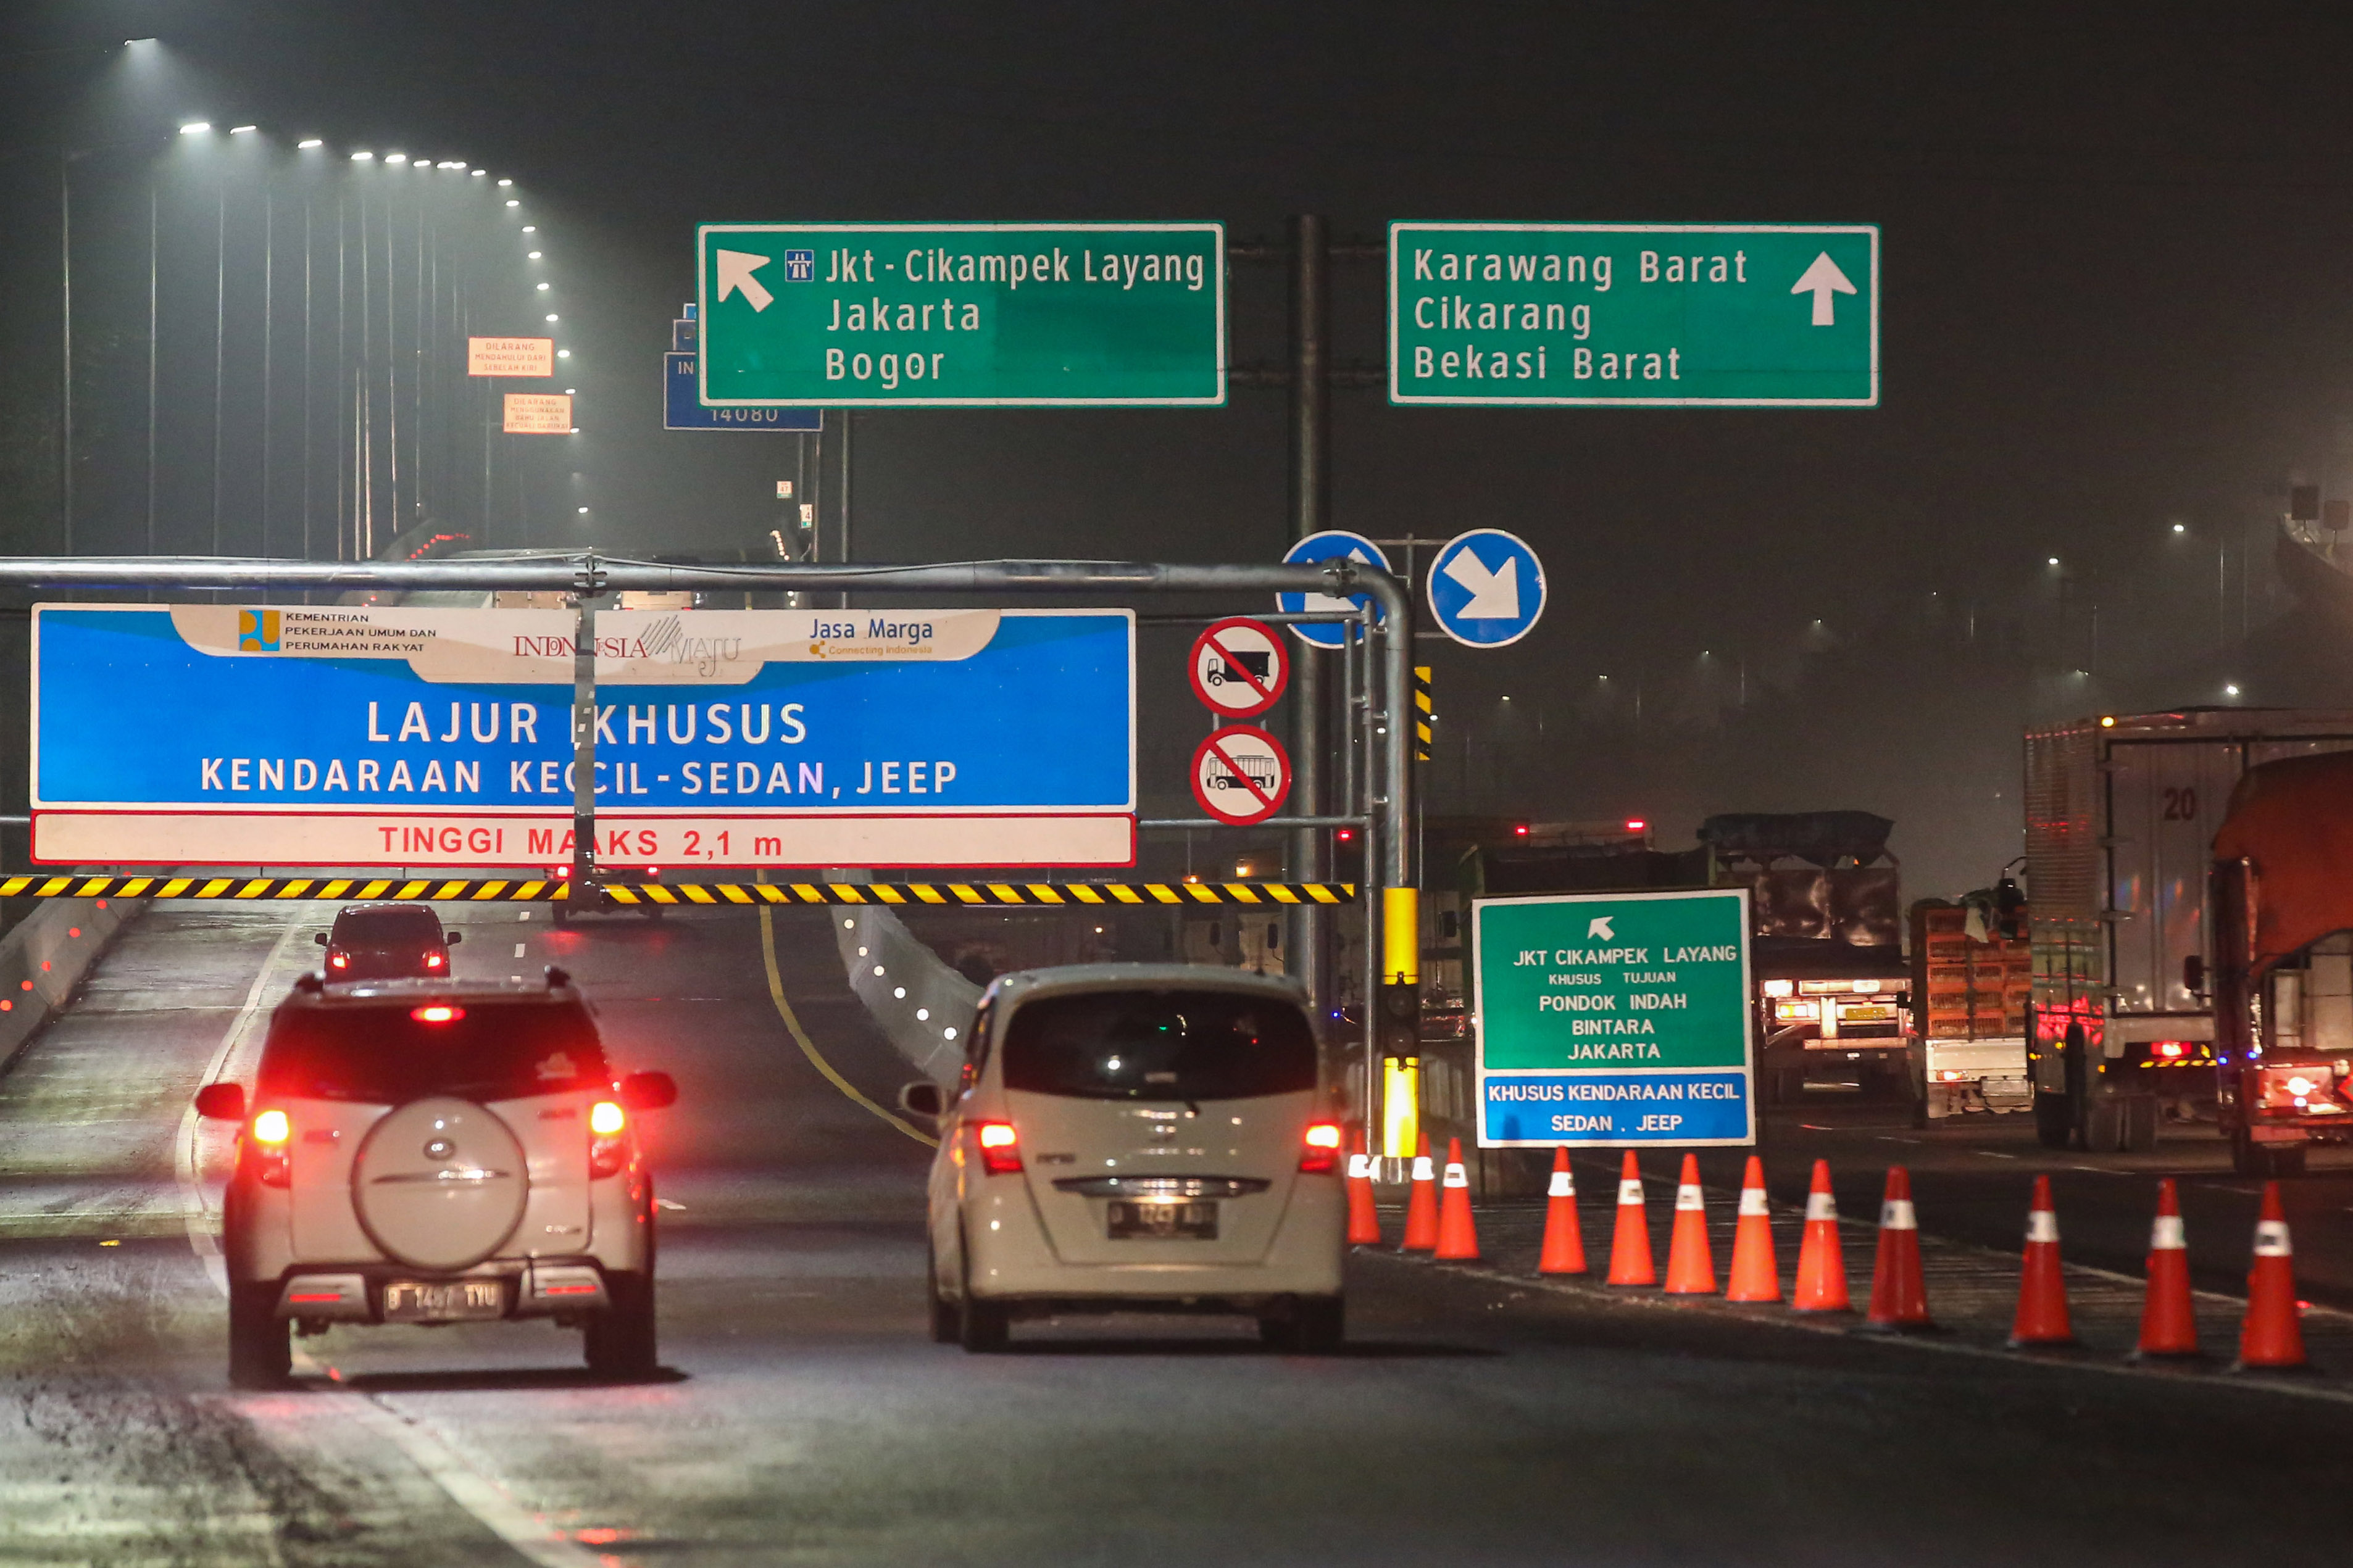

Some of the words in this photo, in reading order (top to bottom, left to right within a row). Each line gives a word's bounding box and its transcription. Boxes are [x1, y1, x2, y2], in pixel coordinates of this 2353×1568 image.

[825, 247, 875, 283] Jkt
[905, 247, 1070, 290] Cikampek
[1085, 249, 1203, 291] Layang
[1415, 249, 1612, 292] Karawang
[1640, 250, 1747, 283] Barat
[827, 297, 980, 331] Jakarta
[1415, 295, 1591, 340] Cikarang
[486, 342, 535, 351] DILARANG
[826, 348, 944, 390] Bogor
[1415, 344, 1546, 379] Bekasi
[1573, 347, 1680, 380] Barat
[286, 613, 369, 623] KEMENTRIAN
[285, 626, 364, 636] PEKERJAAN
[369, 629, 406, 637] UMUM
[409, 629, 436, 637] DAN
[810, 618, 855, 639] Jasa
[868, 618, 933, 645] Marga
[286, 641, 369, 651] PERUMAHAN
[373, 643, 424, 652] RAKYAT
[829, 646, 883, 656] Connecting
[886, 645, 933, 655] Indonesia
[368, 701, 538, 744] LAJUR
[570, 703, 806, 744] KHUSUS
[202, 758, 480, 793] KENDARAAN
[856, 761, 957, 794] JEEP
[2164, 787, 2195, 821] 20
[378, 826, 502, 853] TINGGI
[528, 829, 658, 856] MAKS
[683, 830, 729, 860] 2,1
[754, 837, 781, 856] m
[1513, 950, 1548, 966] JKT
[1555, 948, 1649, 965] CIKAMPEK
[1664, 945, 1737, 963] LAYANG
[1548, 973, 1602, 985] KHUSUS
[1623, 971, 1676, 984] TUJUAN
[1539, 995, 1616, 1011] PONDOK
[1630, 993, 1687, 1010] INDAH
[1572, 1018, 1655, 1035] BINTARA
[1567, 1043, 1661, 1060] JAKARTA
[1488, 1084, 1565, 1101] KHUSUS
[1568, 1084, 1683, 1101] KENDARAAN
[1688, 1082, 1740, 1100] KECIL
[1551, 1114, 1612, 1132] SEDAN
[1636, 1114, 1683, 1132] JEEP
